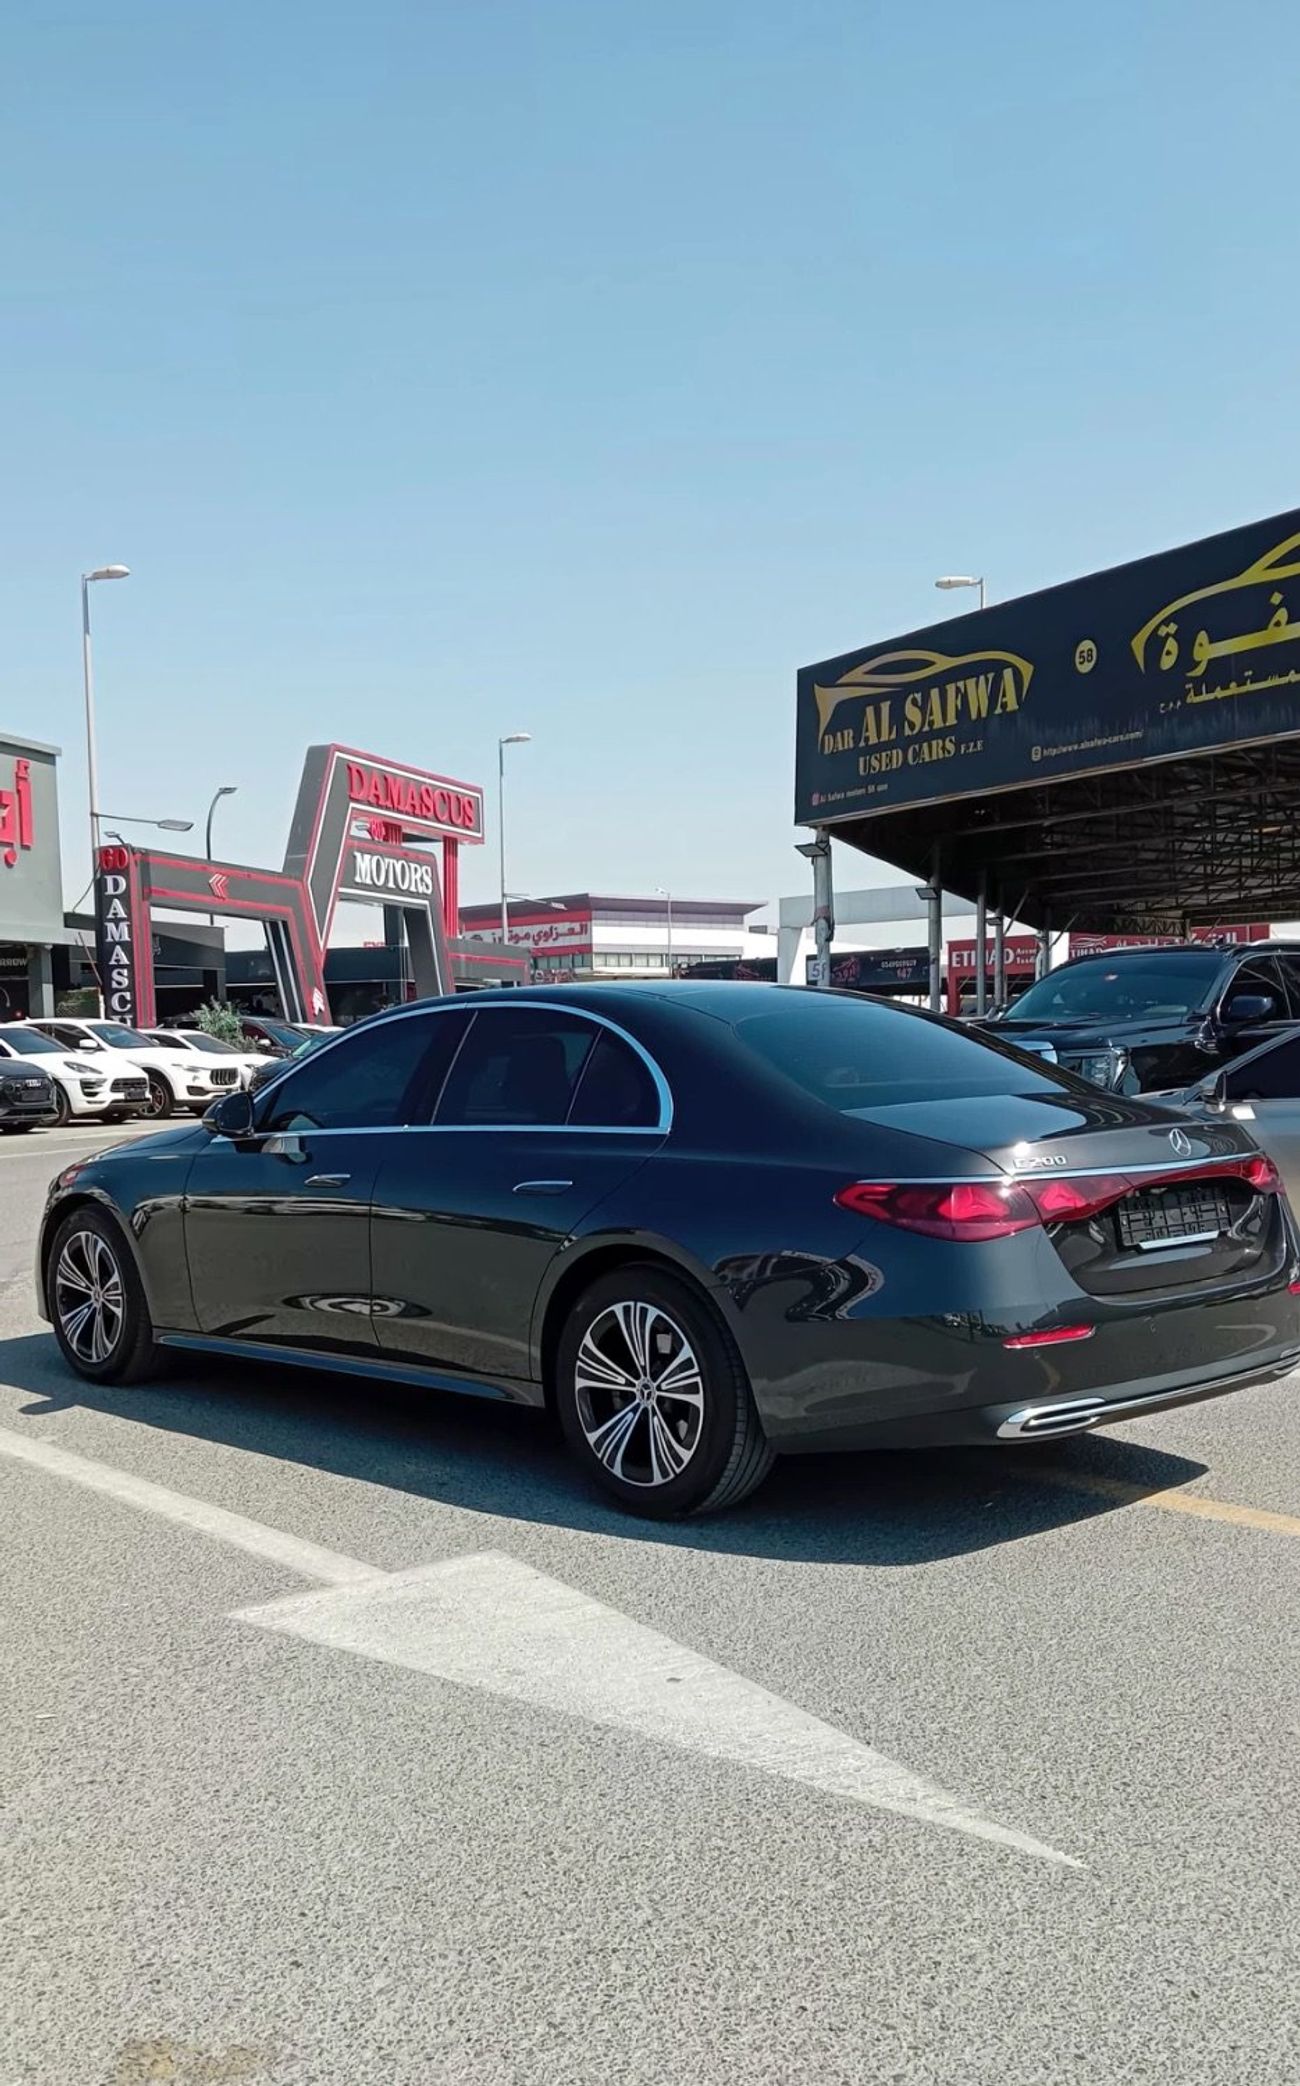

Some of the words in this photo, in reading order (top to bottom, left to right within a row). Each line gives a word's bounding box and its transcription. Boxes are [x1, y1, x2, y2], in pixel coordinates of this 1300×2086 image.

[1077, 648, 1094, 665] 58
[1159, 592, 1300, 677] فوة
[823, 729, 855, 755] DAR
[859, 700, 897, 748] AL
[904, 667, 1019, 738] SAFWA
[858, 746, 903, 776] USED
[907, 736, 957, 766] CARS
[347, 763, 476, 828] DAMASCUS
[101, 847, 130, 871] 60
[353, 851, 433, 895] MOTORS
